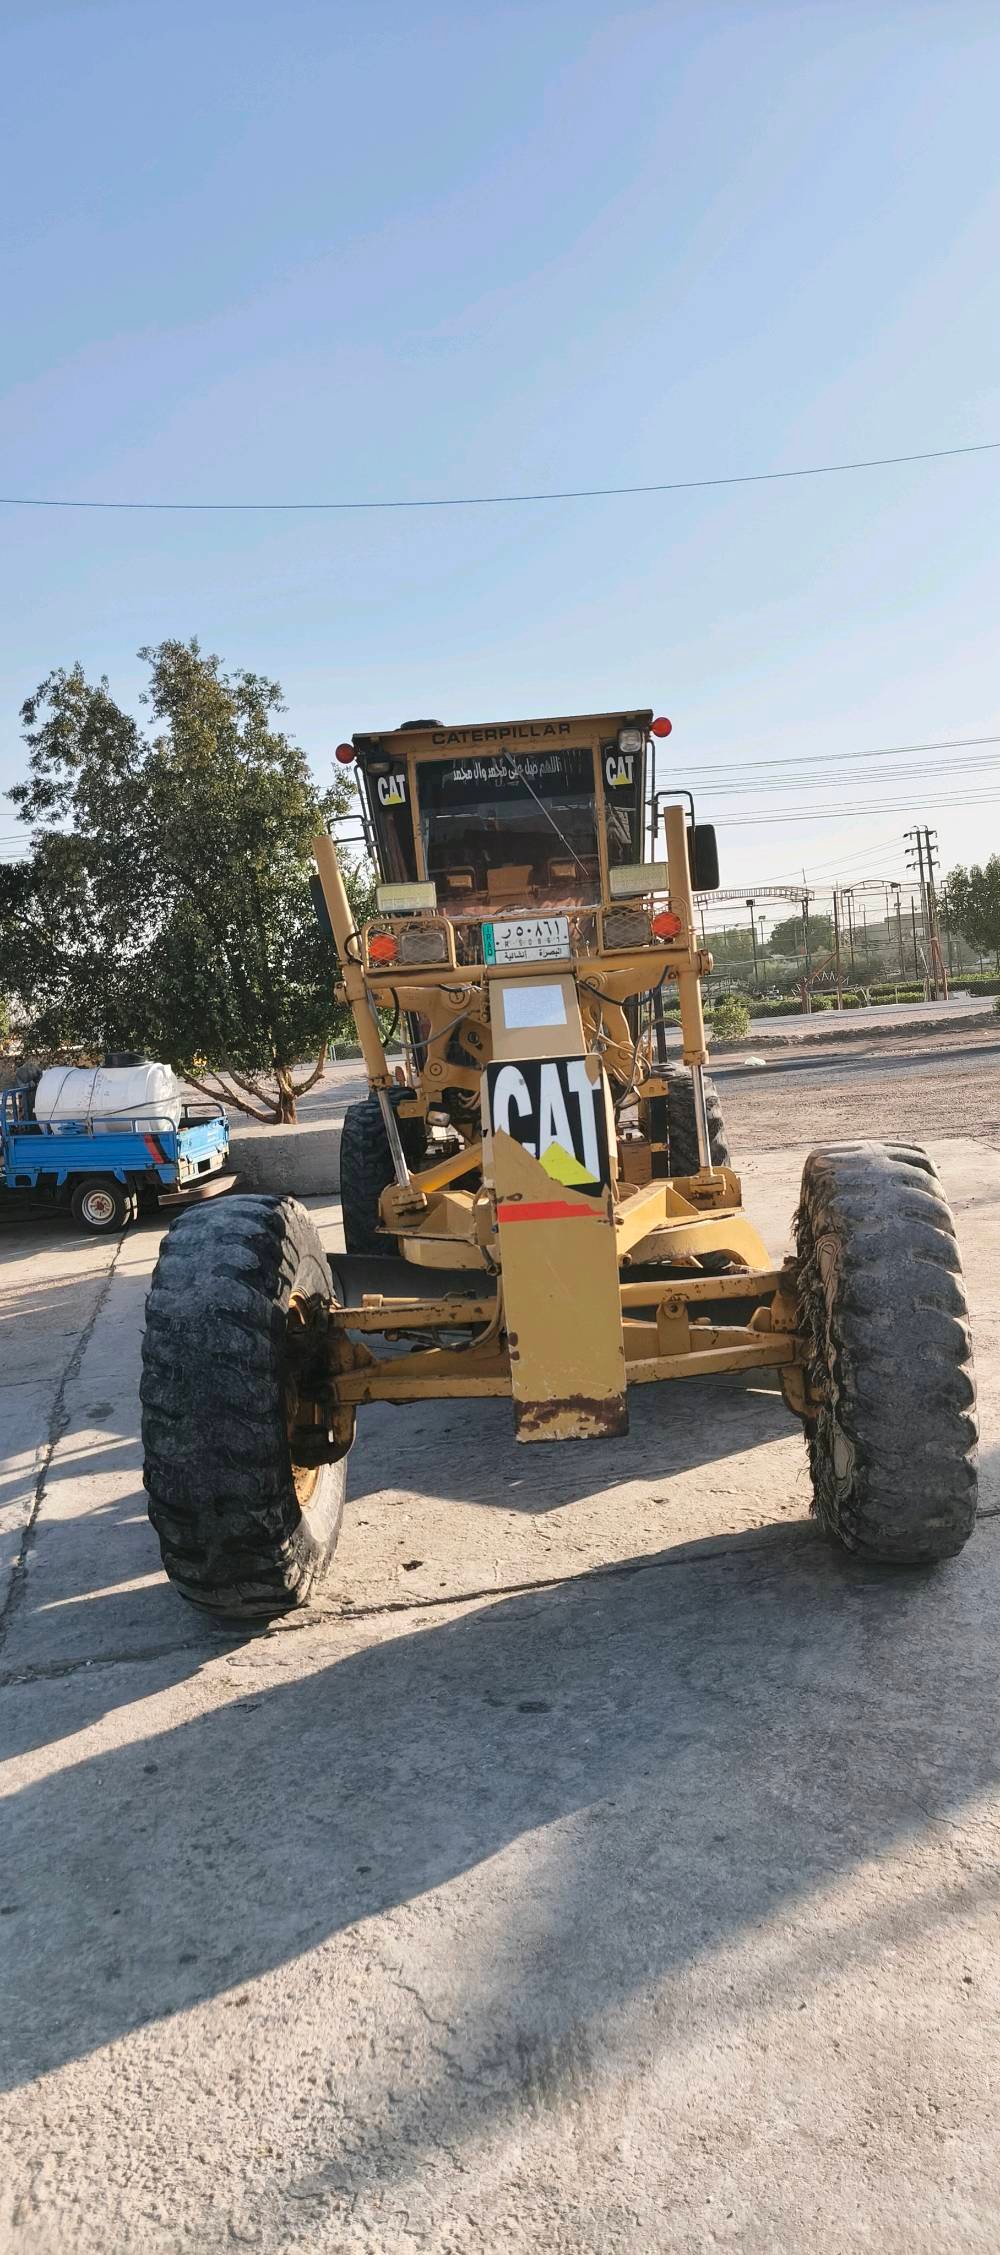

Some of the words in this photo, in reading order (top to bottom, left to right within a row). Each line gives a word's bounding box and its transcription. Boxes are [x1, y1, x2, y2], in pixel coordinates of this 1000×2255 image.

[432, 723, 571, 745] CATERPILLAR
[453, 766, 472, 781] محمد
[605, 755, 634, 785] CAT
[377, 774, 406, 805] CAT
[493, 1060, 602, 1183] CAT
